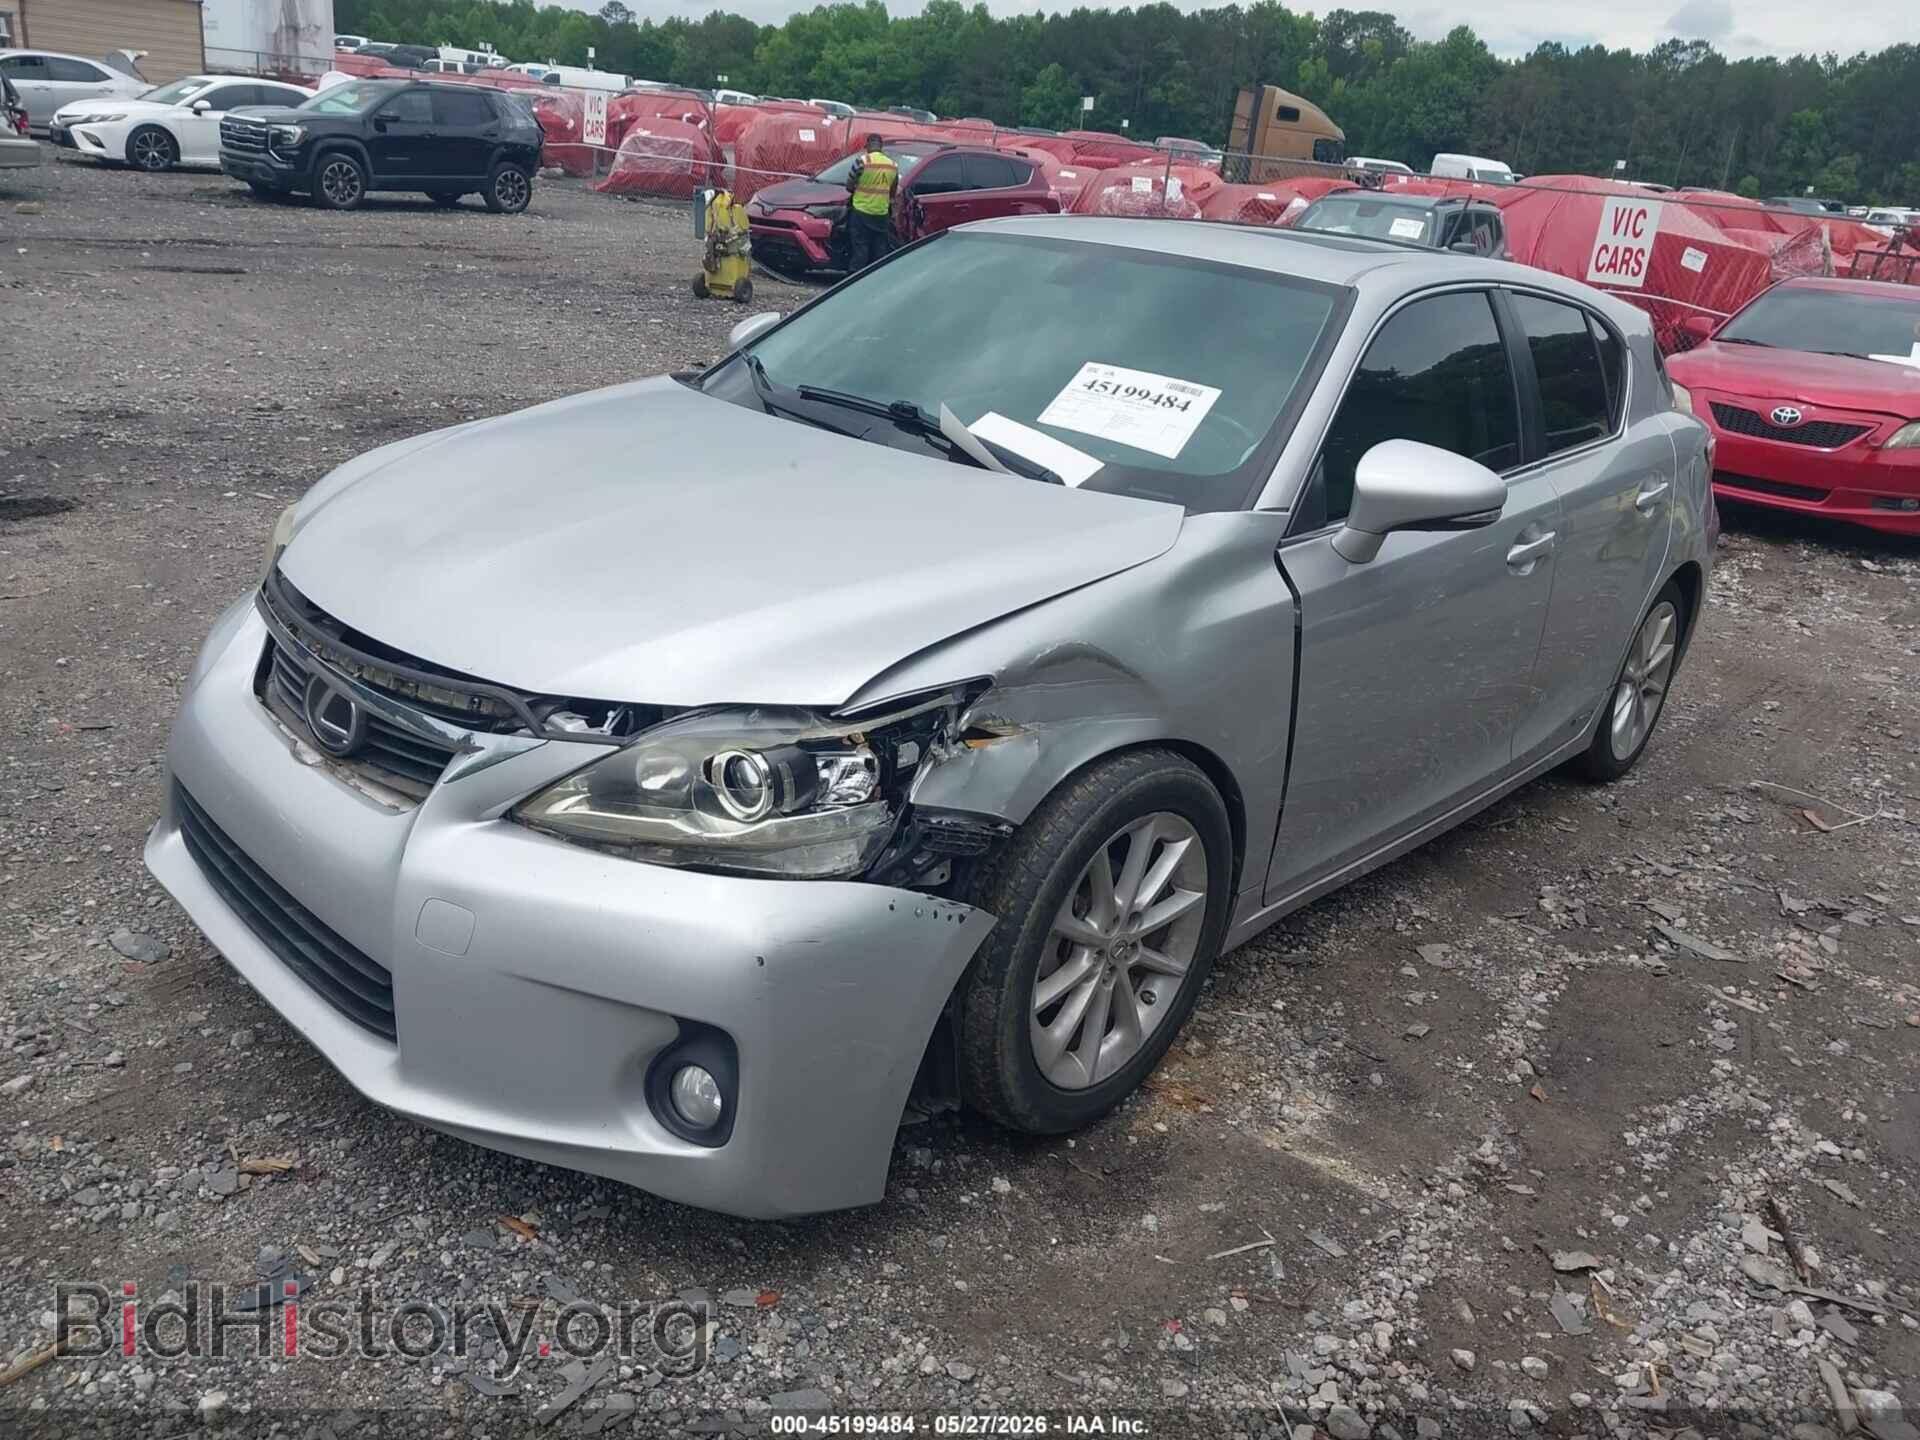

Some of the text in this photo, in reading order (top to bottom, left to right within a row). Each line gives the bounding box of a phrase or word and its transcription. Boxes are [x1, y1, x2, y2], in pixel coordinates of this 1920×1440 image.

[589, 95, 602, 115] VIC
[585, 119, 604, 138] CARS
[1612, 206, 1647, 239] VIC
[1594, 243, 1646, 277] CARS
[1082, 378, 1193, 413] 45199484
